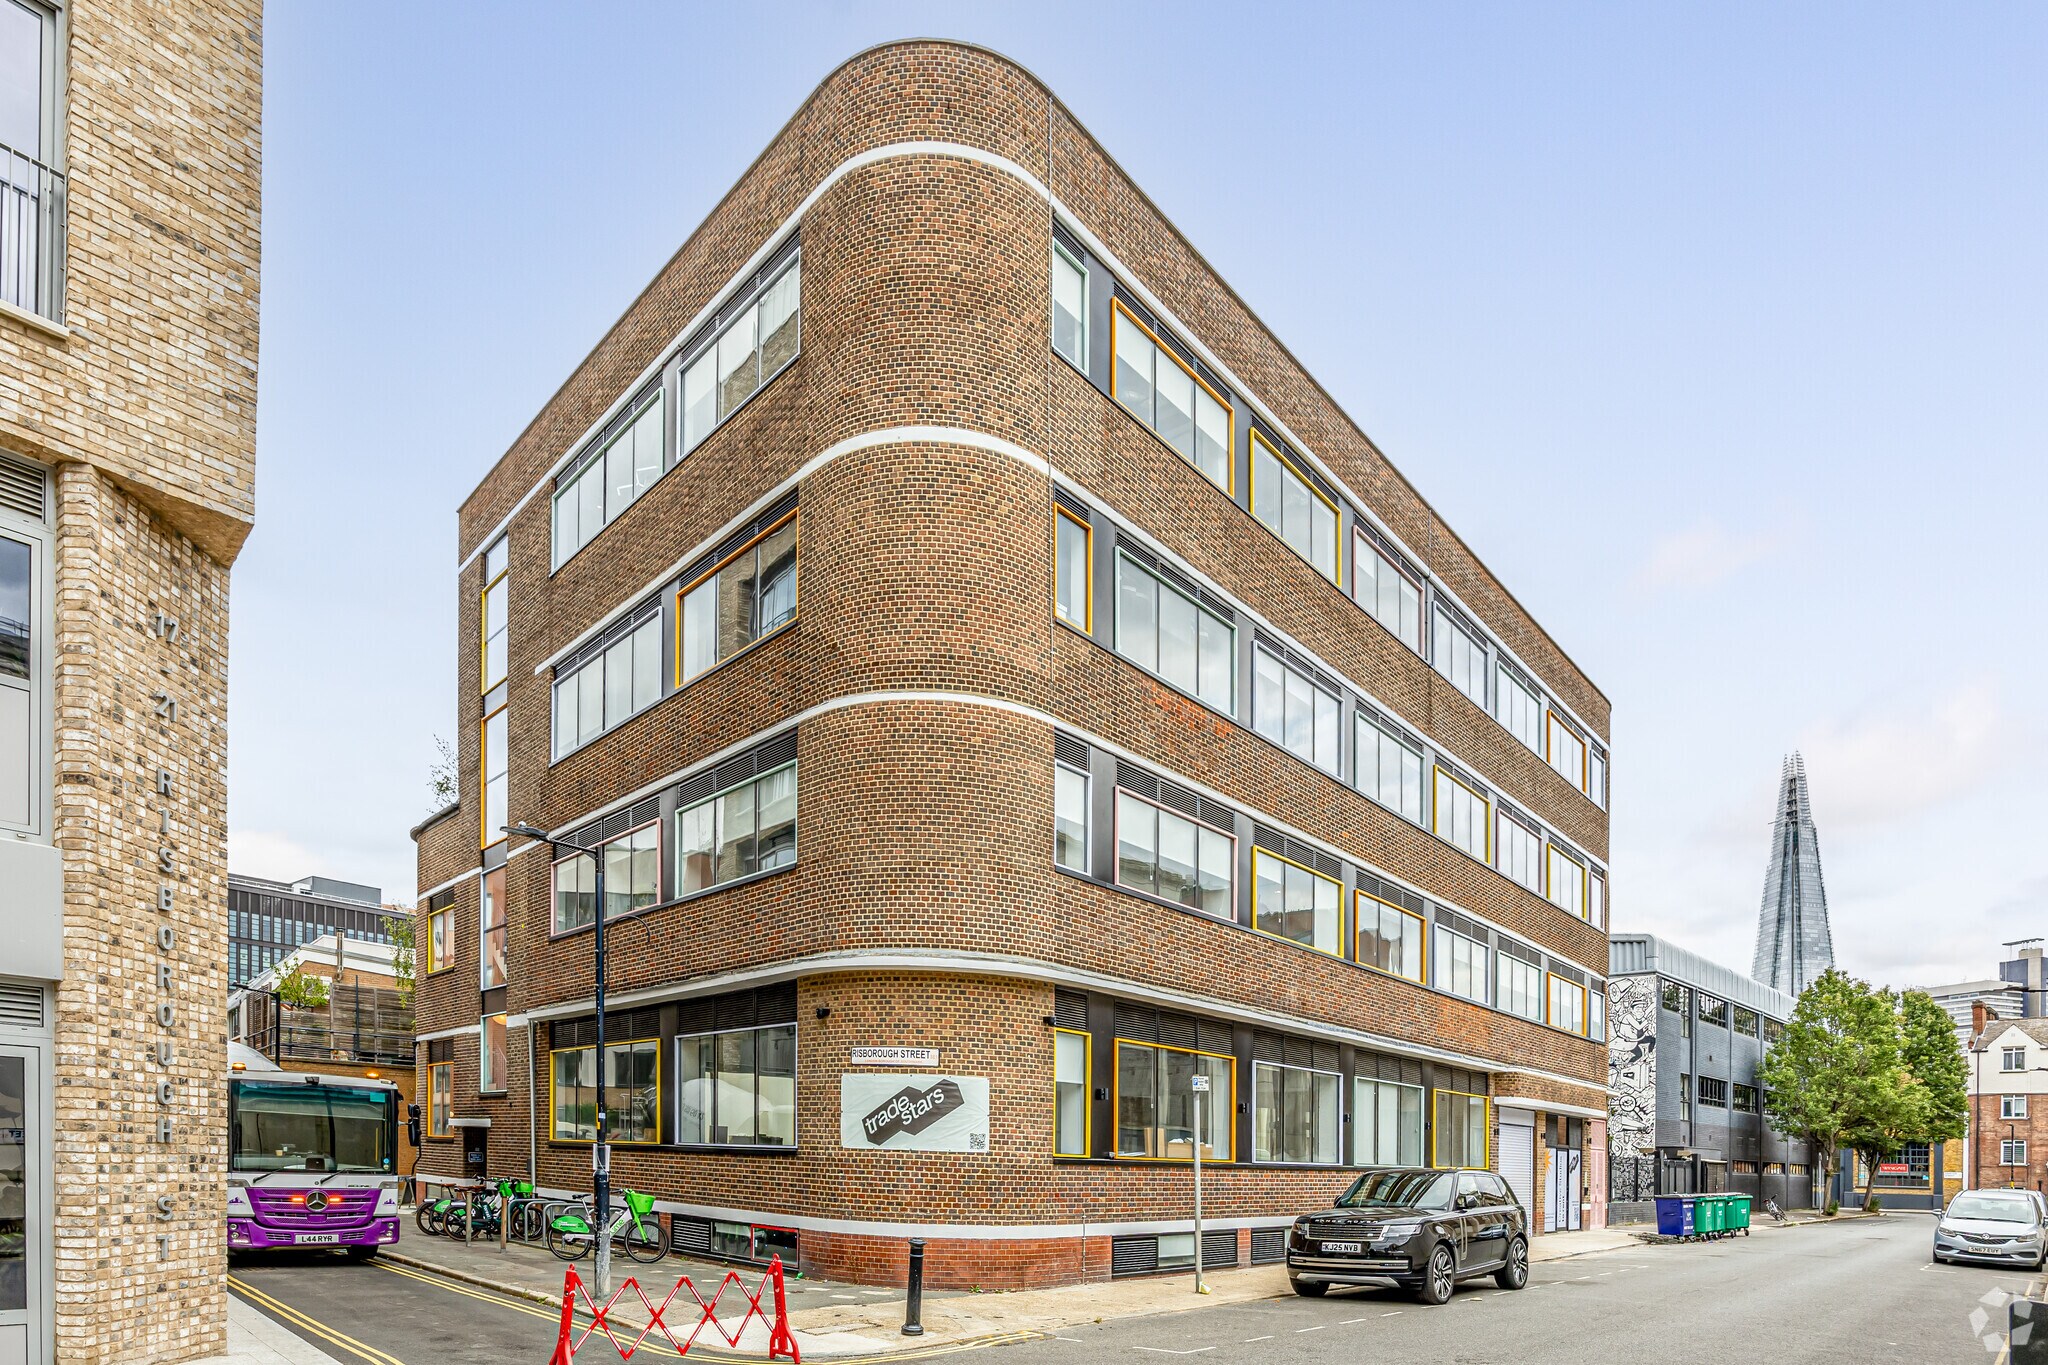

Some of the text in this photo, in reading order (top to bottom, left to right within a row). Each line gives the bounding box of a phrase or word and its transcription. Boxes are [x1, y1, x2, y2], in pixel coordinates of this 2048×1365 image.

[155, 611, 178, 643] 17
[155, 691, 178, 723] 21
[852, 1048, 899, 1058] RISBOROUGH
[900, 1049, 931, 1059] STREET
[864, 1094, 910, 1135] trade
[900, 1088, 945, 1126] stars
[156, 1195, 174, 1260] ST
[1324, 1243, 1342, 1251] KJ25
